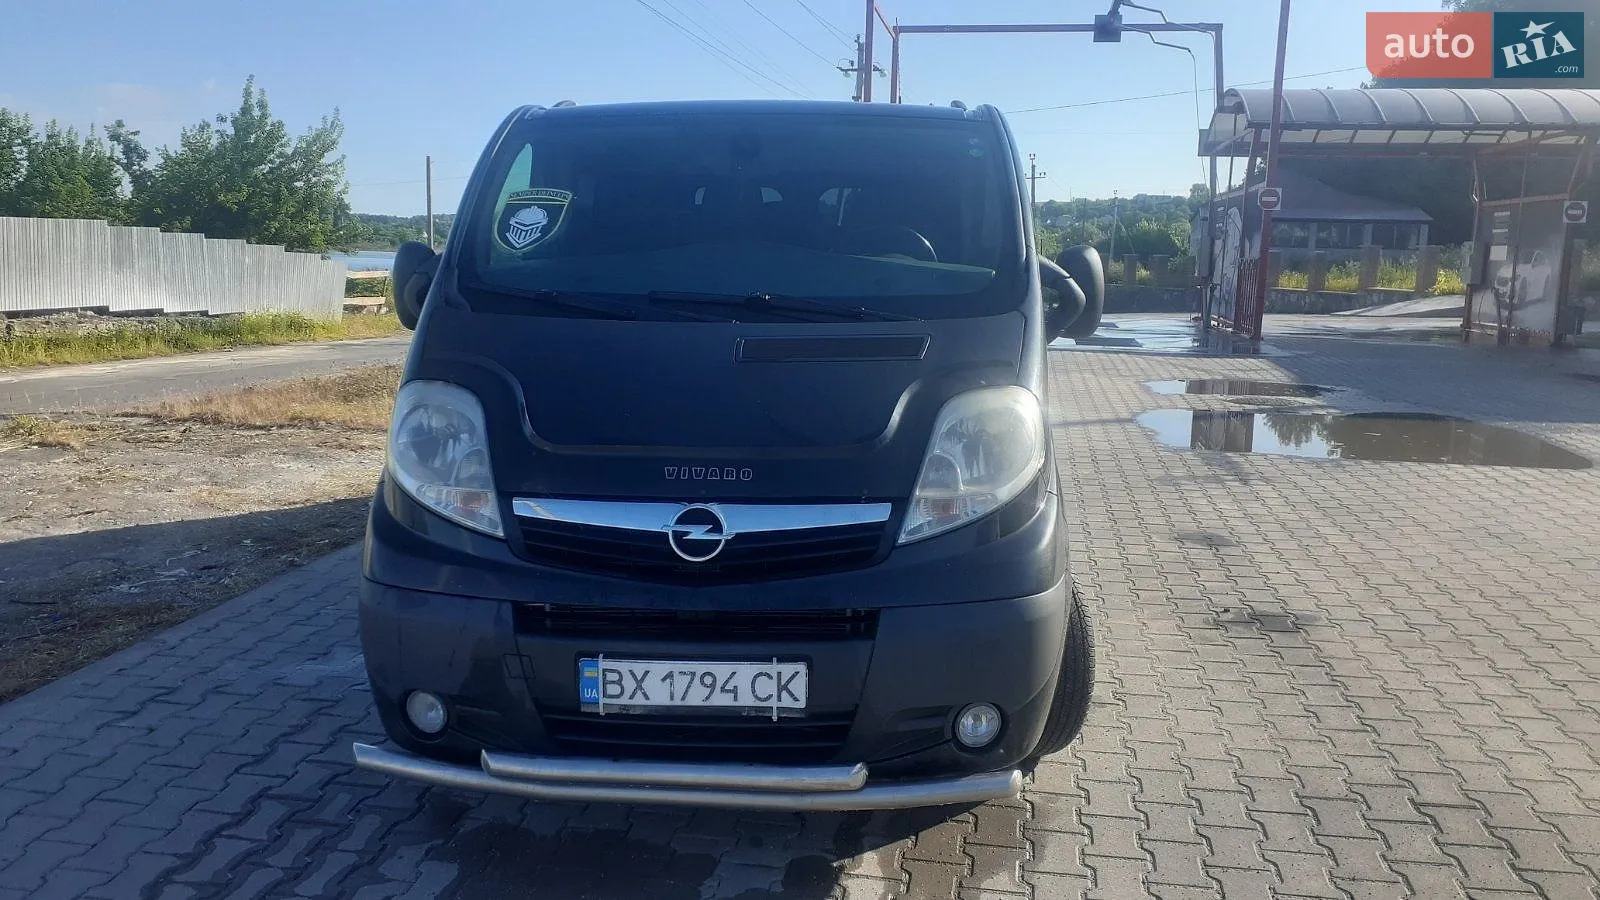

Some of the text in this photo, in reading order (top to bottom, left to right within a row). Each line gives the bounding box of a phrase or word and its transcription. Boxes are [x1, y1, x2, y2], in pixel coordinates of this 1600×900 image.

[665, 466, 753, 481] VIVARO
[602, 668, 801, 702] BX 1794 CK
[584, 688, 598, 699] UA
